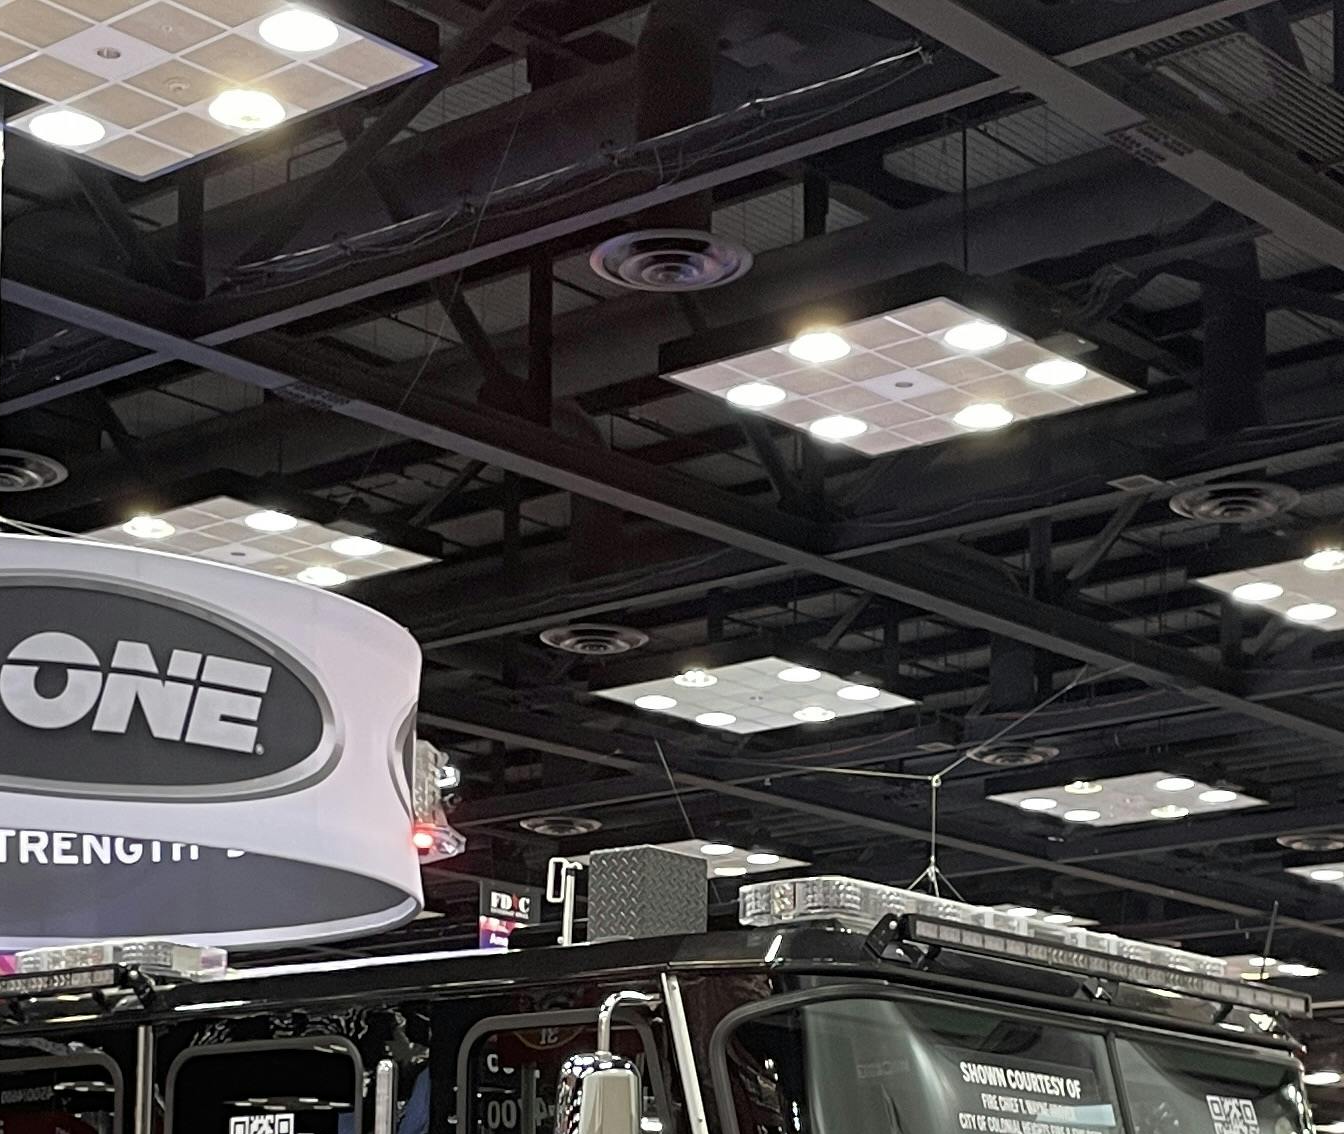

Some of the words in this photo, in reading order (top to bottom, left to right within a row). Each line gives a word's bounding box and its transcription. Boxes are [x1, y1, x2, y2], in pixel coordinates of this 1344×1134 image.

[959, 1061, 1008, 1087] SHOWN
[1007, 1069, 1066, 1097] COURTESY
[1066, 1079, 1081, 1099] OF
[958, 1112, 977, 1130] CITY
[977, 1115, 987, 1131] OF
